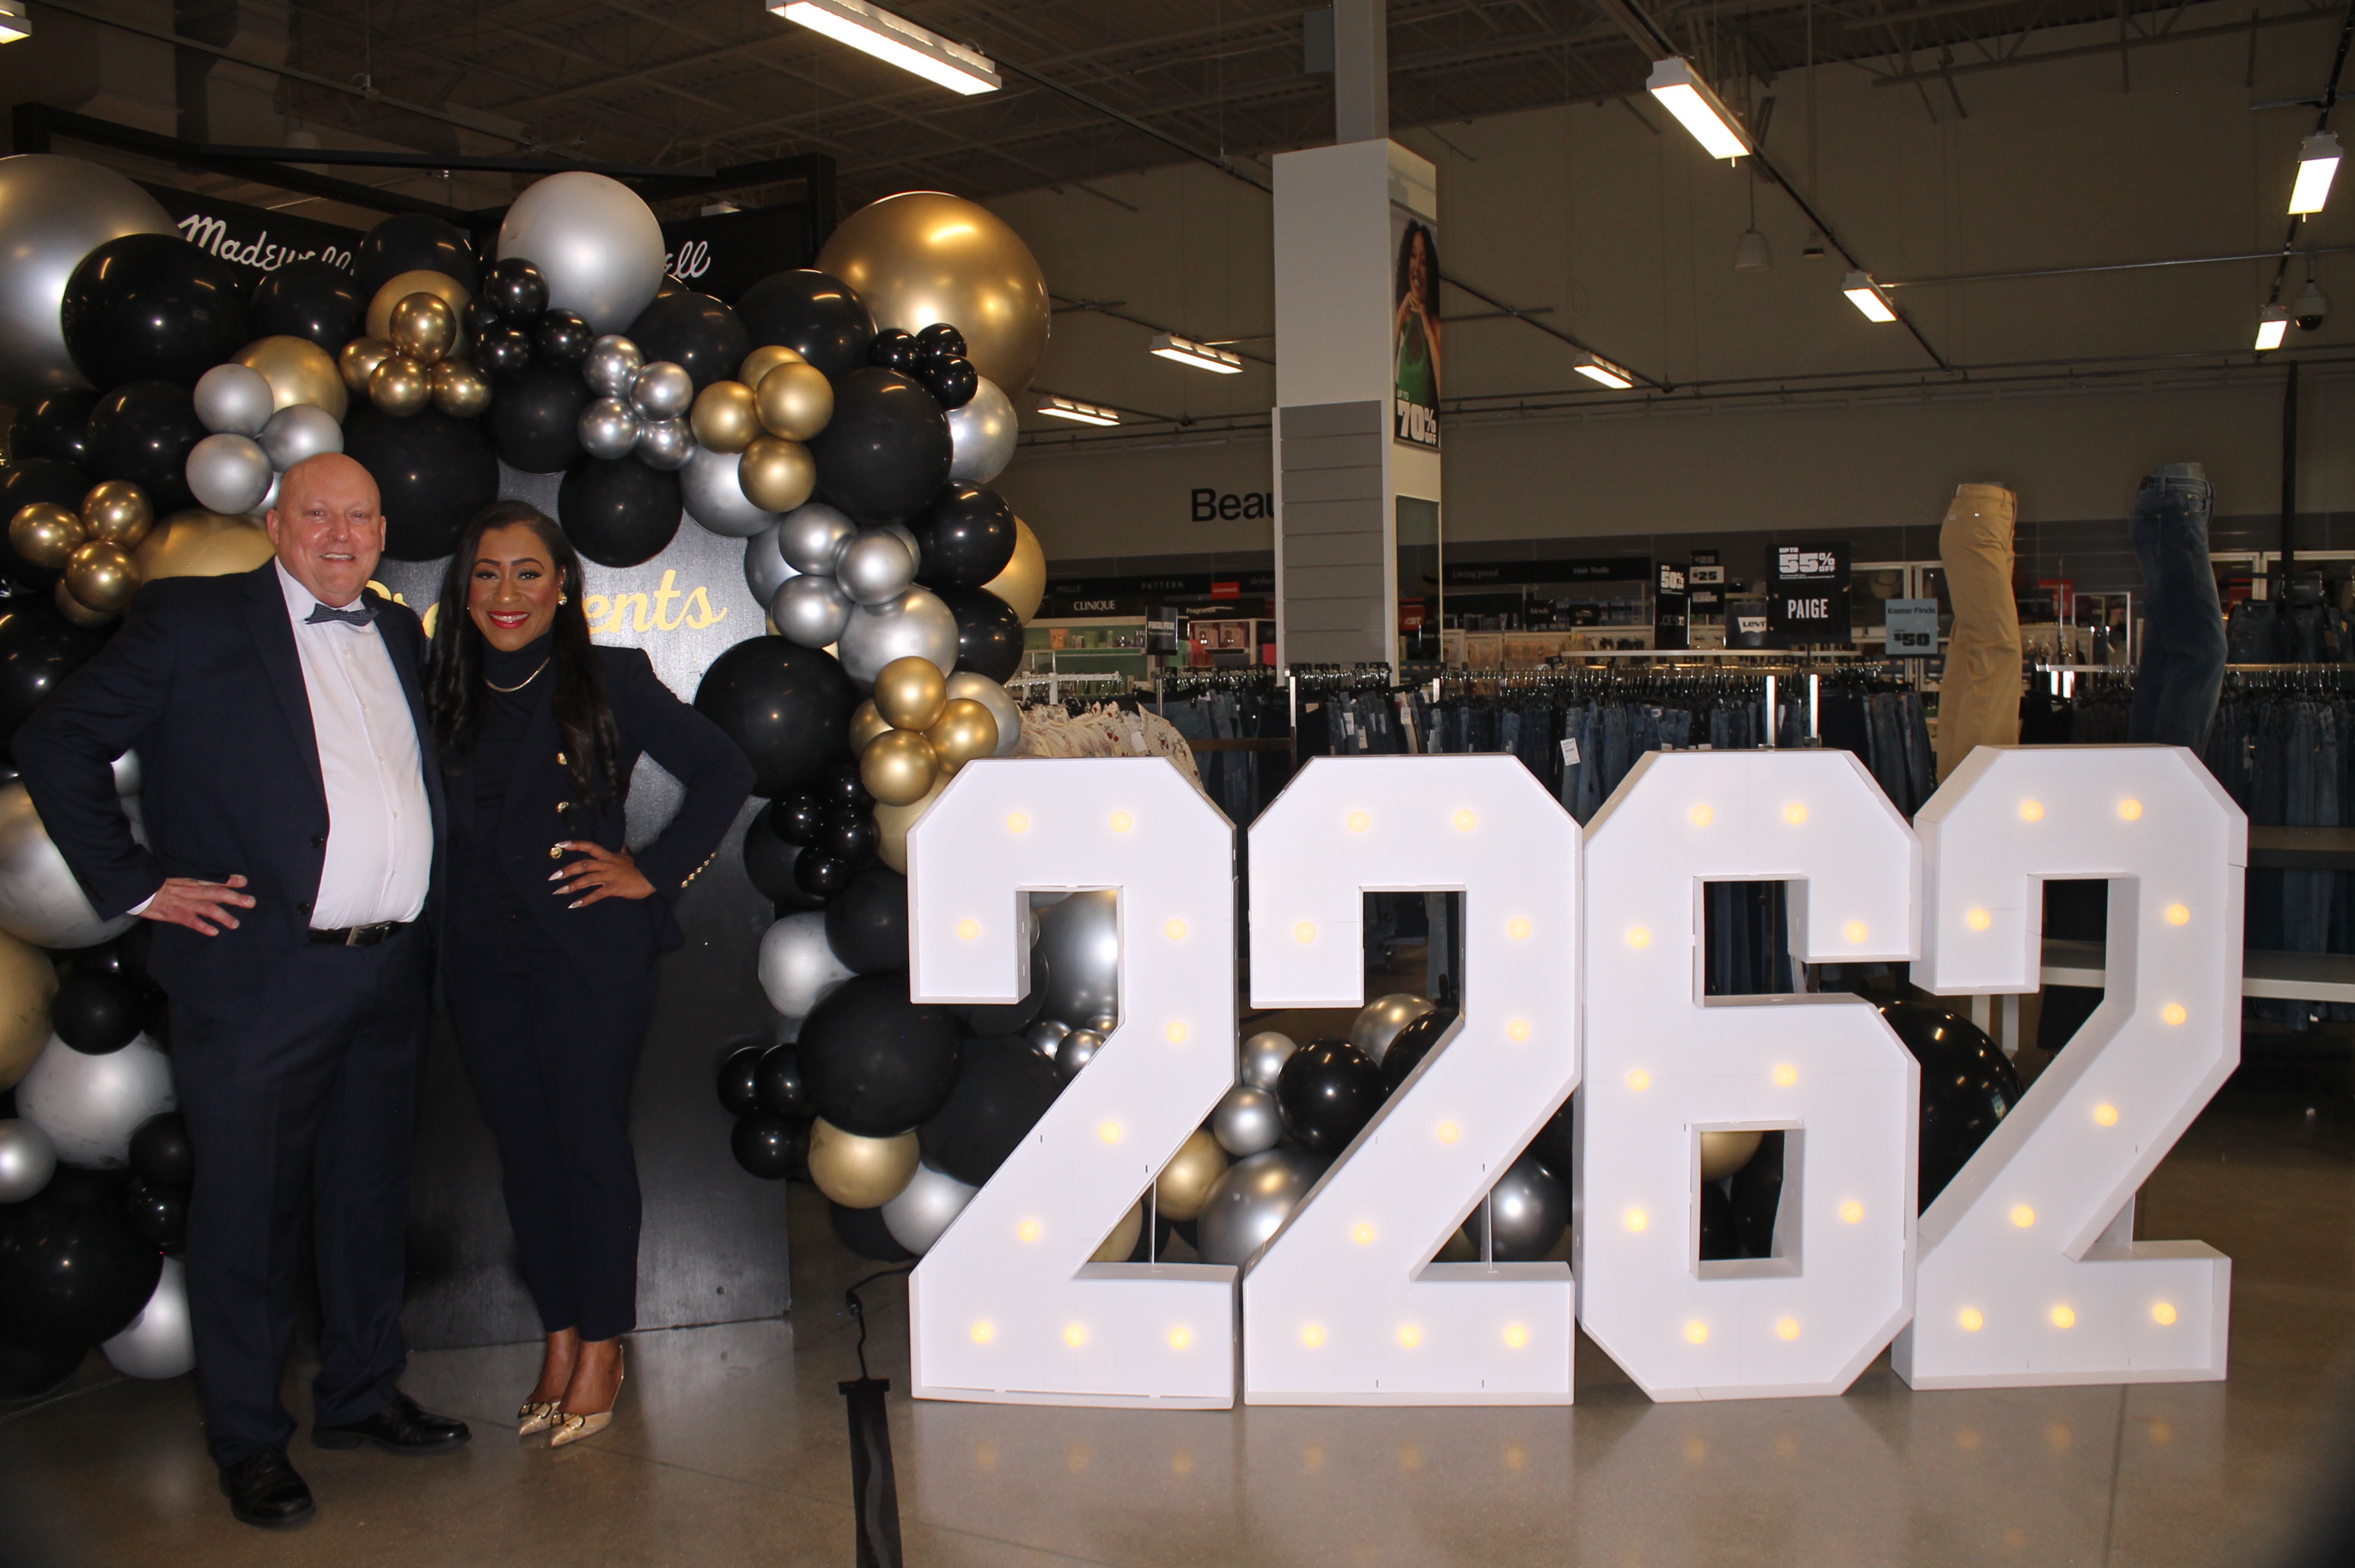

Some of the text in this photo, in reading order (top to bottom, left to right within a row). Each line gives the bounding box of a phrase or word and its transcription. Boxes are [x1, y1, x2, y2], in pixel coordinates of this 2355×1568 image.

[1397, 398, 1437, 442] 70%
[1425, 432, 1437, 445] OFF
[1779, 552, 1835, 574] 55%
[1692, 571, 1717, 580] $25
[1141, 580, 1184, 590] PATTERN
[1073, 600, 1116, 611] CLINIQUE
[1788, 599, 1829, 619] PAIGE
[1894, 633, 1930, 646] $50
[908, 745, 2248, 1409] 2262
